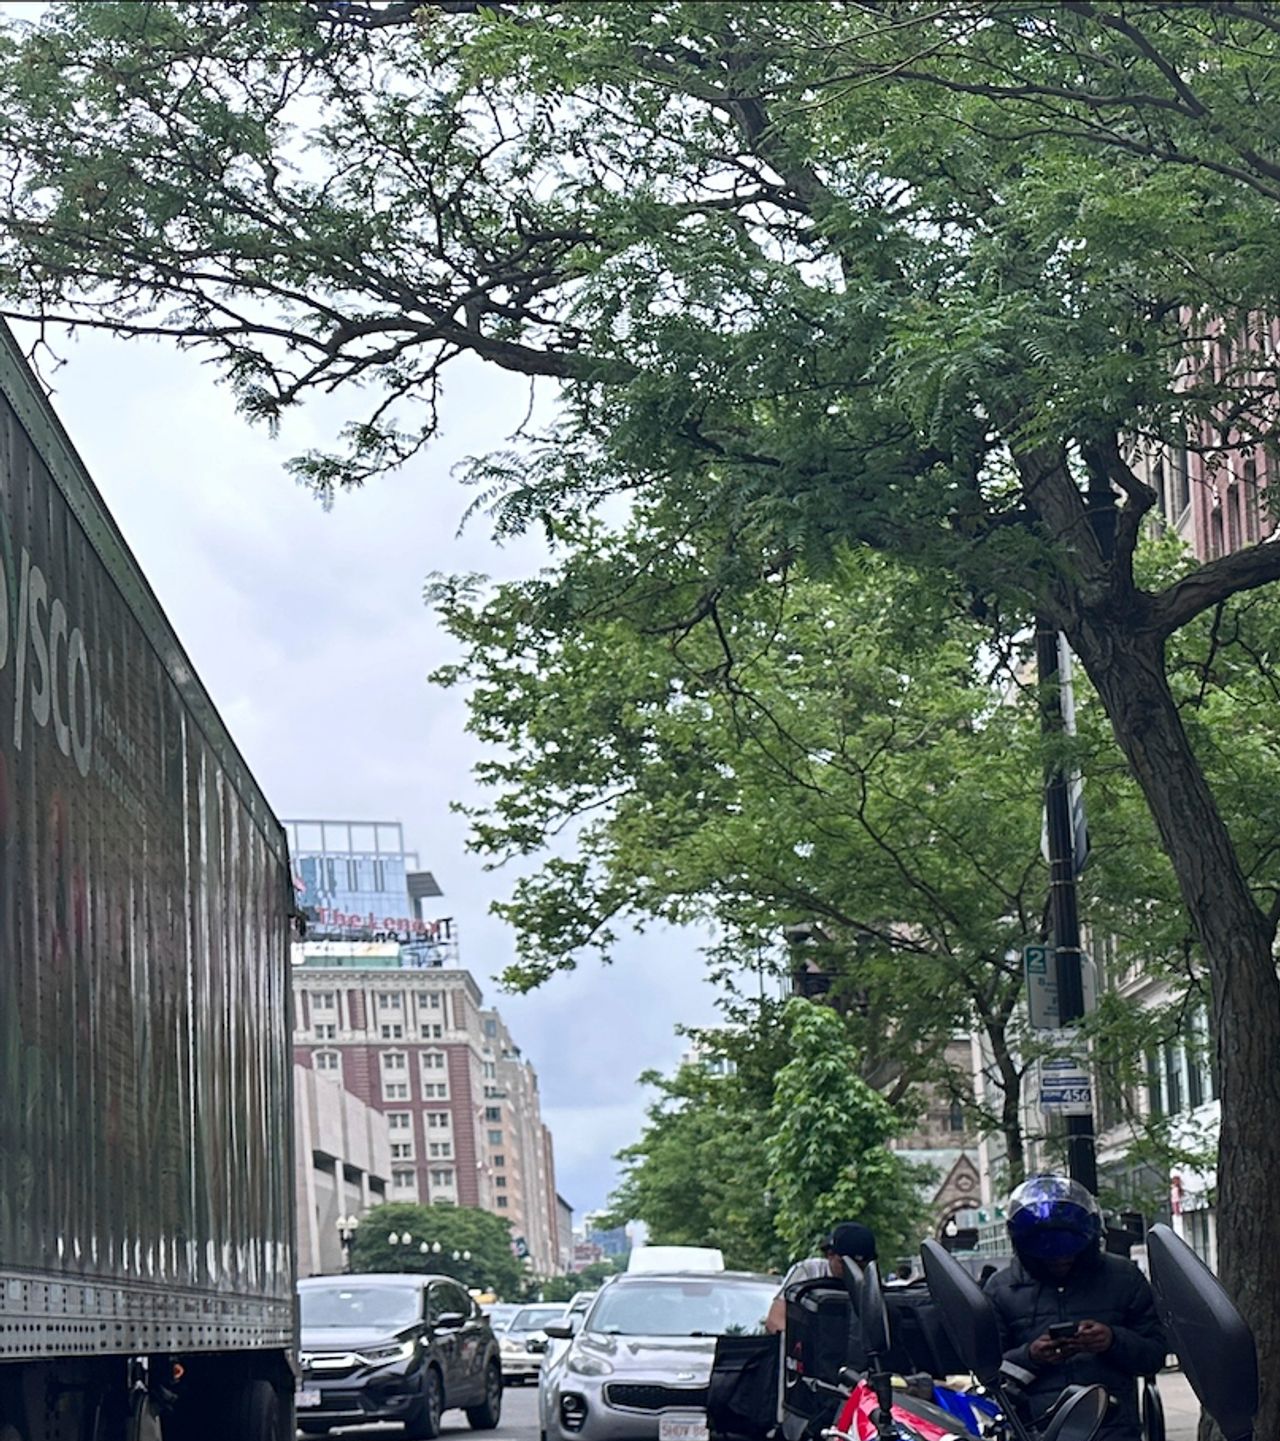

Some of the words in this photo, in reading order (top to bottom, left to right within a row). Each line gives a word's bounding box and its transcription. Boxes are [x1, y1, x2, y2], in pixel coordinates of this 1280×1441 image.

[315, 906, 361, 928] The
[367, 911, 441, 935] Lenox
[1028, 950, 1046, 968] 2
[1062, 1088, 1090, 1102] 456
